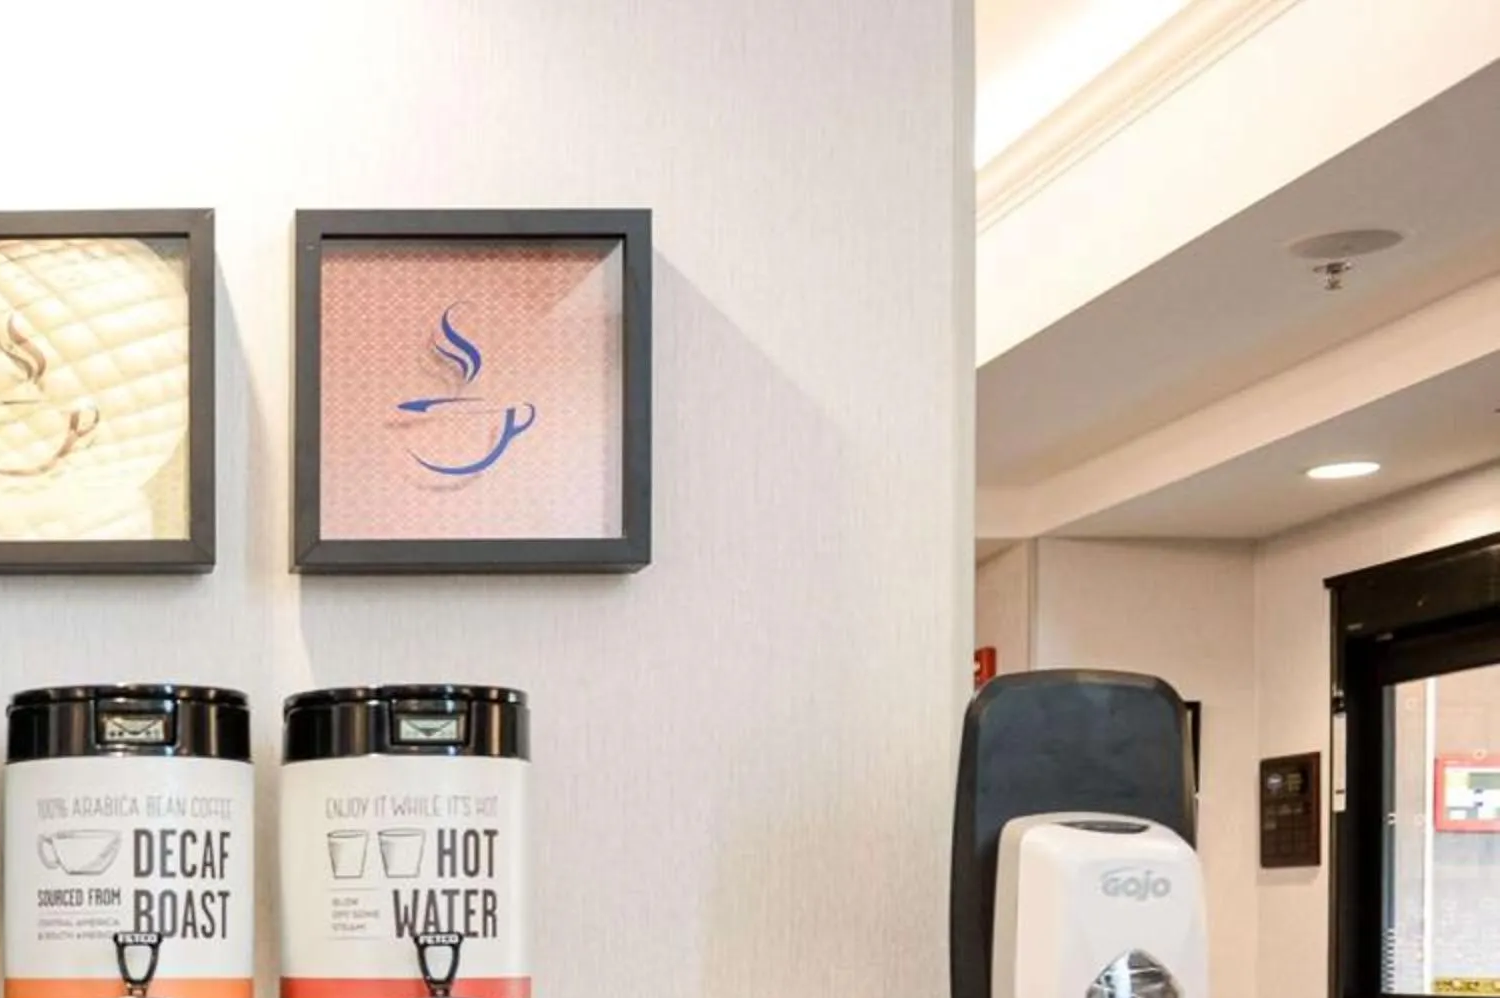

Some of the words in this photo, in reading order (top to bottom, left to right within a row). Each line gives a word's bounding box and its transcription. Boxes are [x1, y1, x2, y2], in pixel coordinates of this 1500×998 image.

[72, 795, 140, 818] ARABICA
[133, 828, 231, 880] DECAF
[437, 828, 499, 879] HOT
[37, 887, 85, 908] SOURCED
[88, 887, 121, 906] FROM
[133, 888, 231, 940] ROAST
[392, 888, 498, 939] WATER
